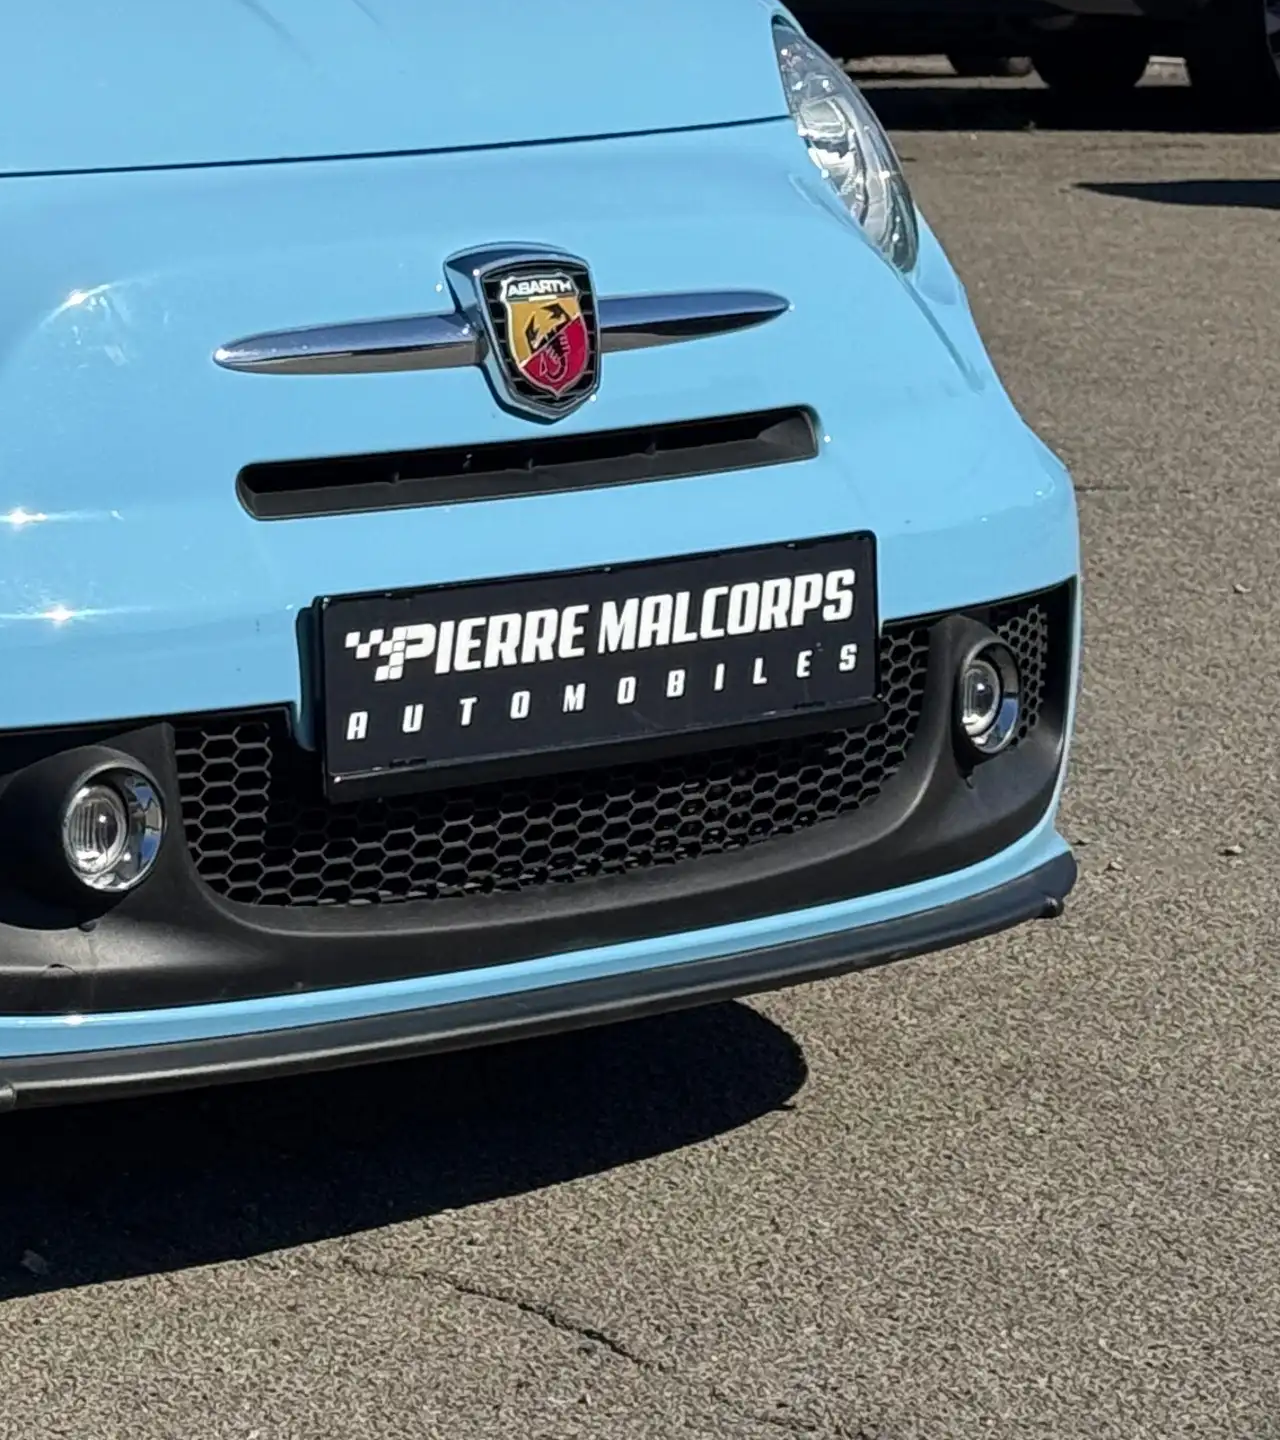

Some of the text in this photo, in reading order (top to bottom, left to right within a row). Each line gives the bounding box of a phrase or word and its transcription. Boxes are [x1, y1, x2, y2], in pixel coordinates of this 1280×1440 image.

[507, 279, 573, 297] ABARTH
[374, 568, 855, 681] PIERRE MALCORPS
[346, 643, 857, 740] AUTOMOBILES
